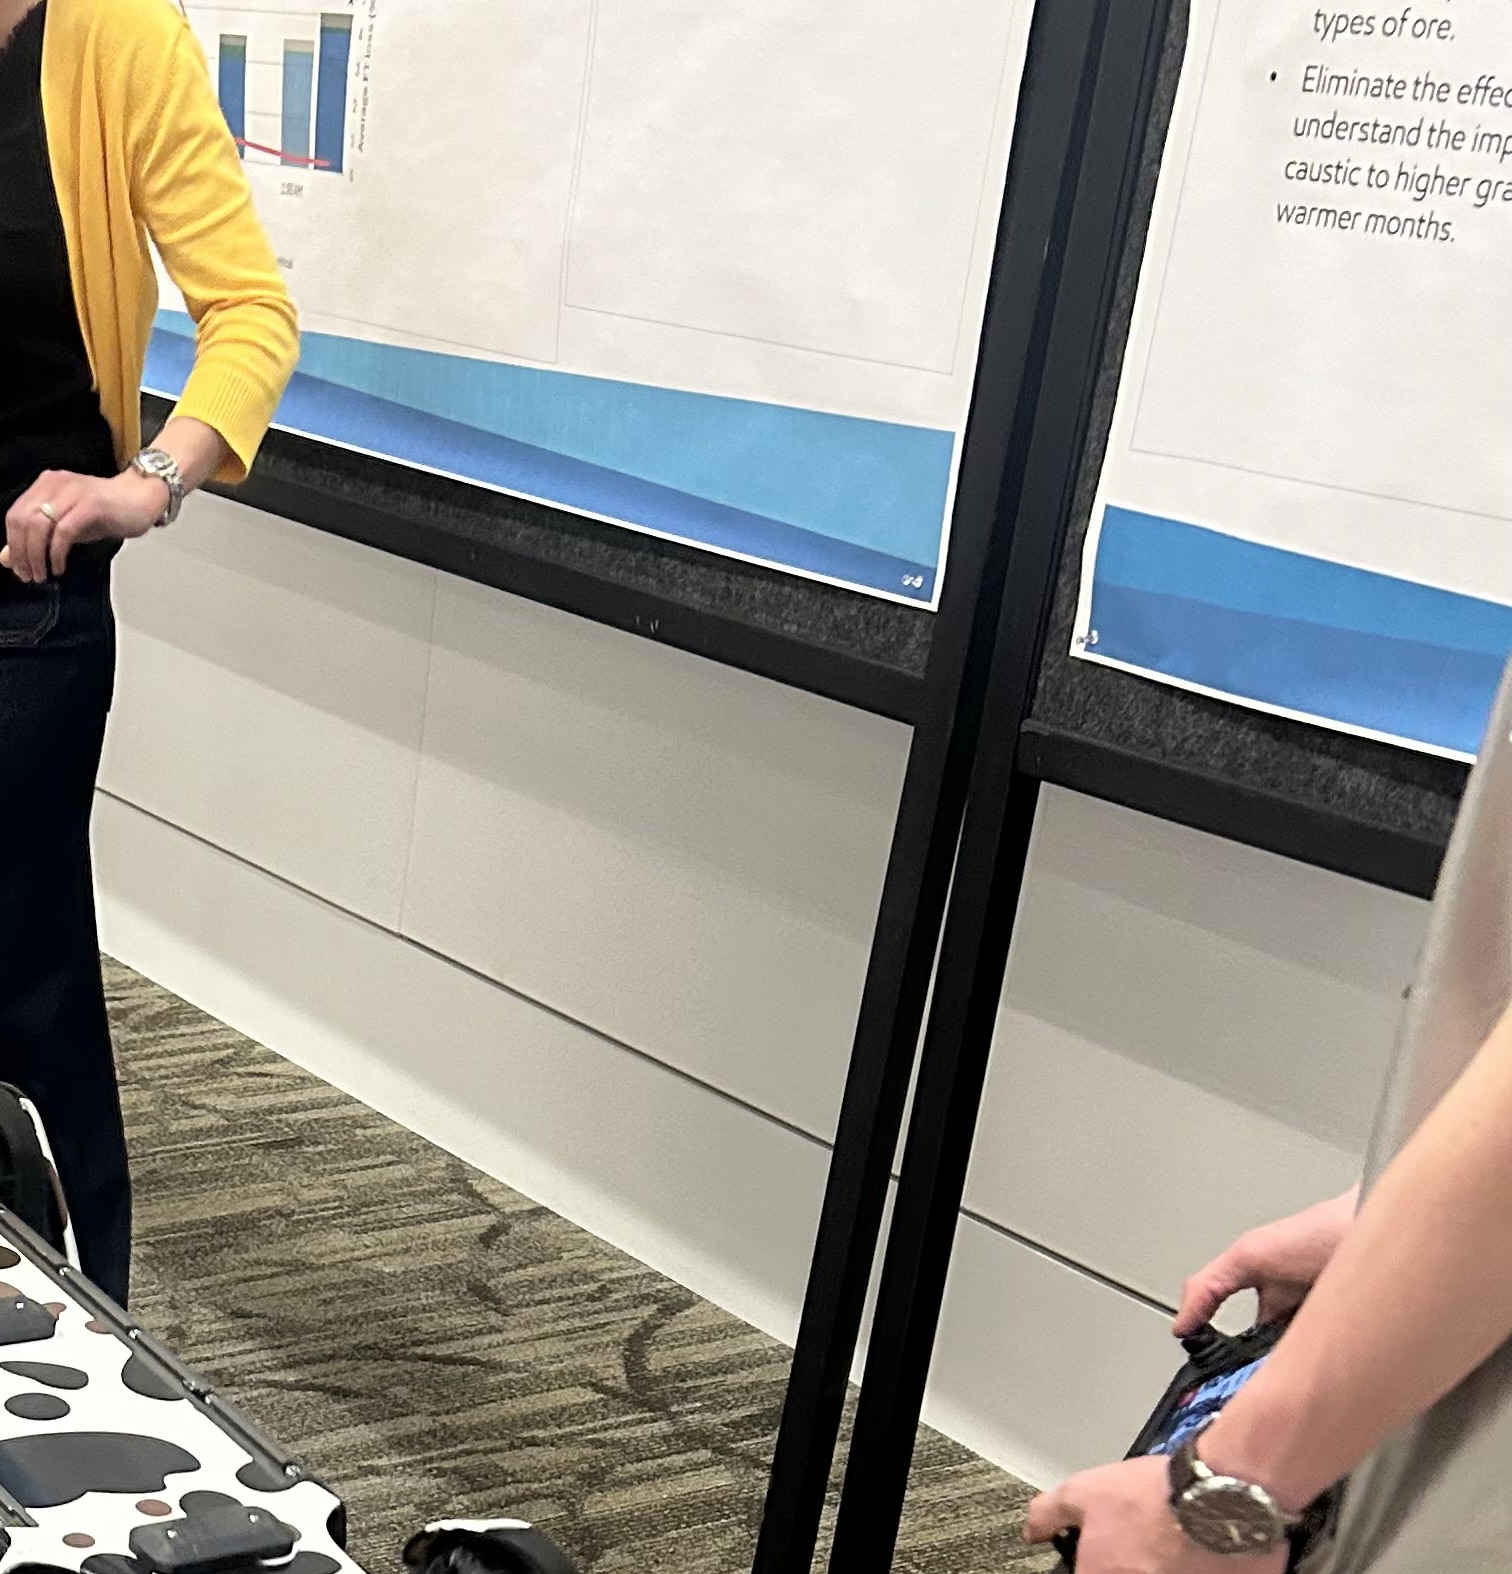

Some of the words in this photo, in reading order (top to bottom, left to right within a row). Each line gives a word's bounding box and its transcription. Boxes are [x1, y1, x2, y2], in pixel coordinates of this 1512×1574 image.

[1313, 9, 1375, 43] types
[1381, 7, 1411, 37] of
[1410, 17, 1455, 41] ore.
[1301, 64, 1407, 99] Eliminate
[1411, 70, 1451, 103] the
[1293, 110, 1424, 147] understand
[1426, 119, 1467, 152] the
[1284, 157, 1361, 187] caustic
[1366, 165, 1389, 188] to
[1394, 161, 1471, 203] higher
[1276, 203, 1361, 231] warmer
[1364, 210, 1455, 243] months.
